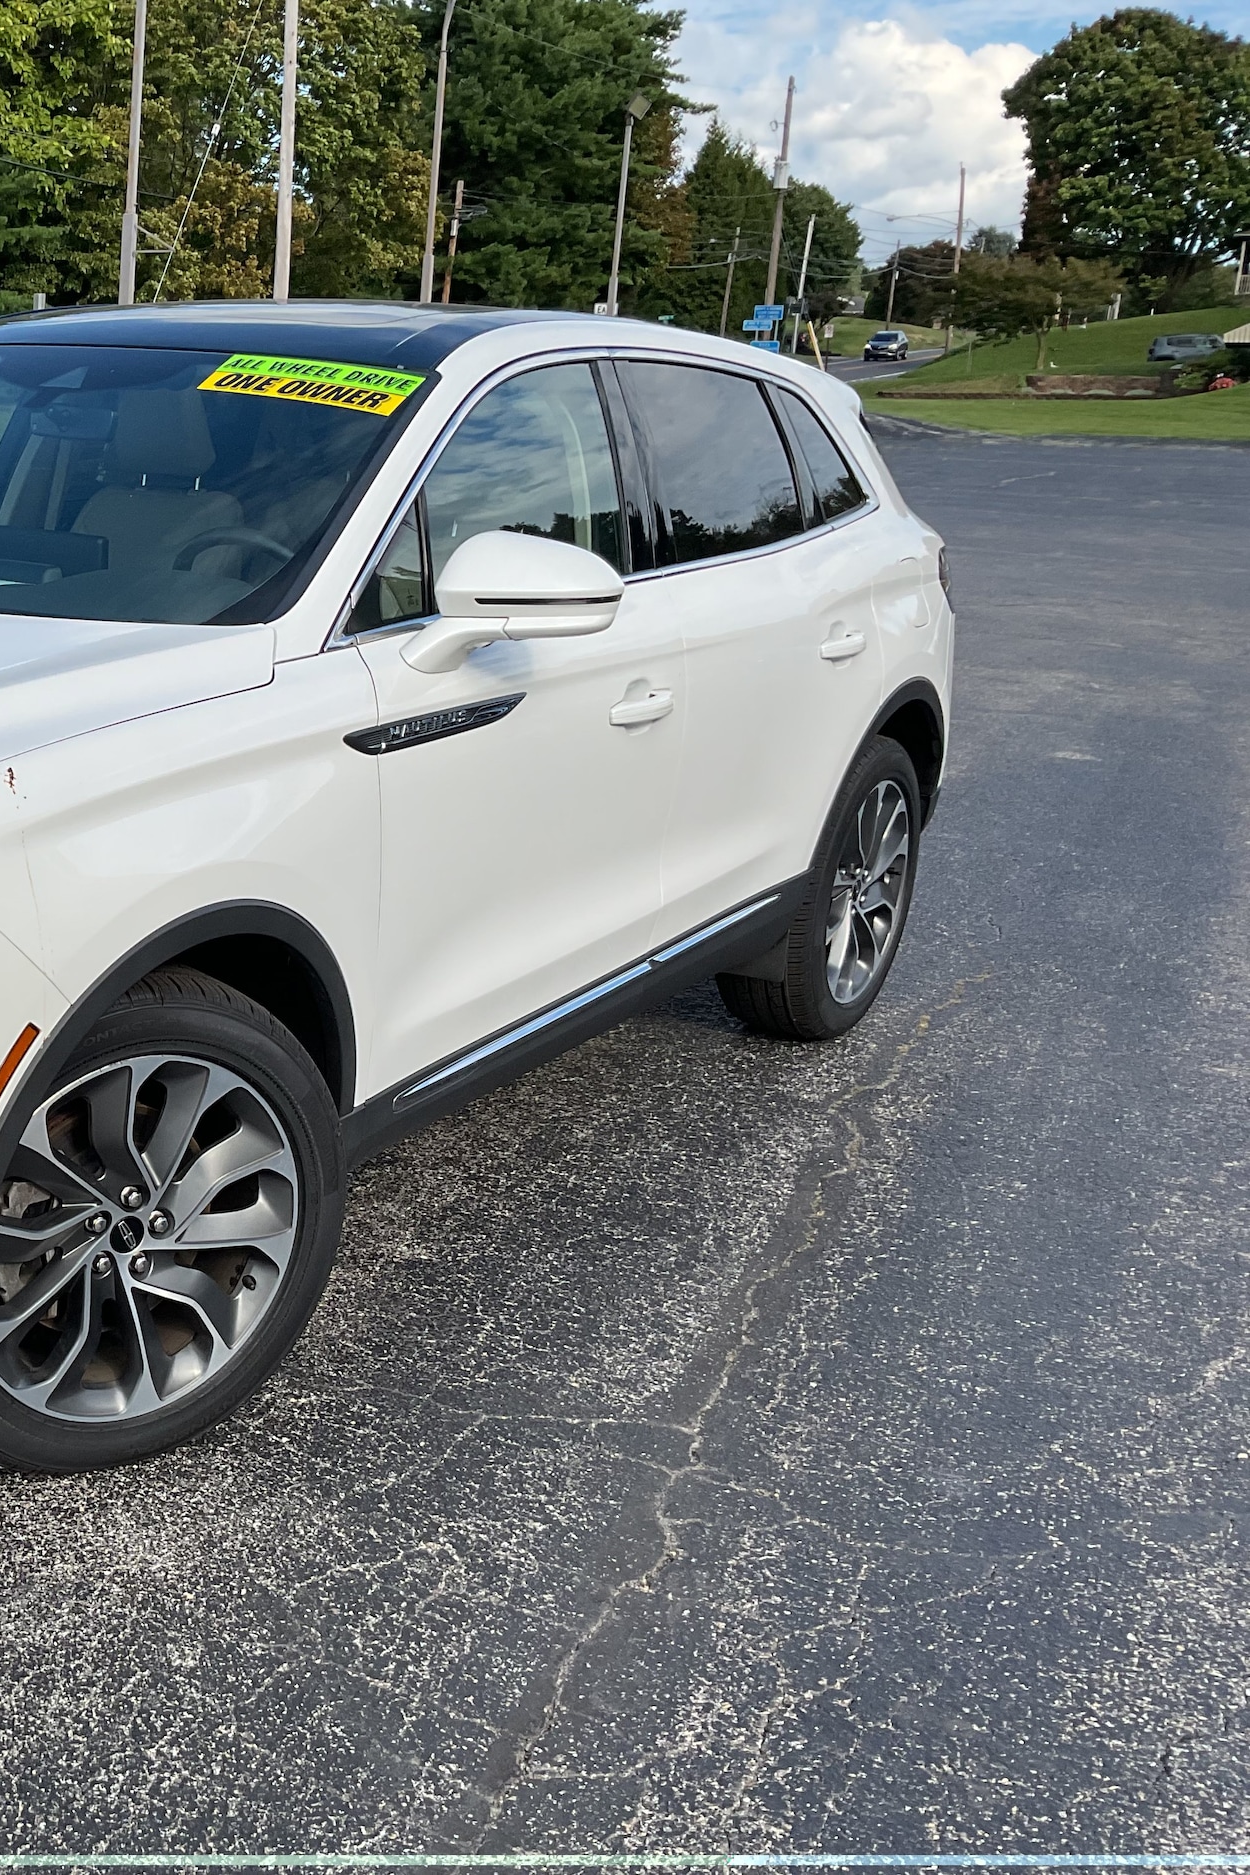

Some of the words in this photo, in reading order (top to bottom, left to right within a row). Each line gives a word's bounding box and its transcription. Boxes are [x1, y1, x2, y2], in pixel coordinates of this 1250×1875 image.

[214, 373, 281, 392] ONE
[278, 380, 391, 411] OWNER
[224, 358, 261, 371] ALL
[268, 360, 341, 380] WHEEL
[339, 370, 418, 392] DRIVE
[389, 709, 467, 738] NAUTILUS
